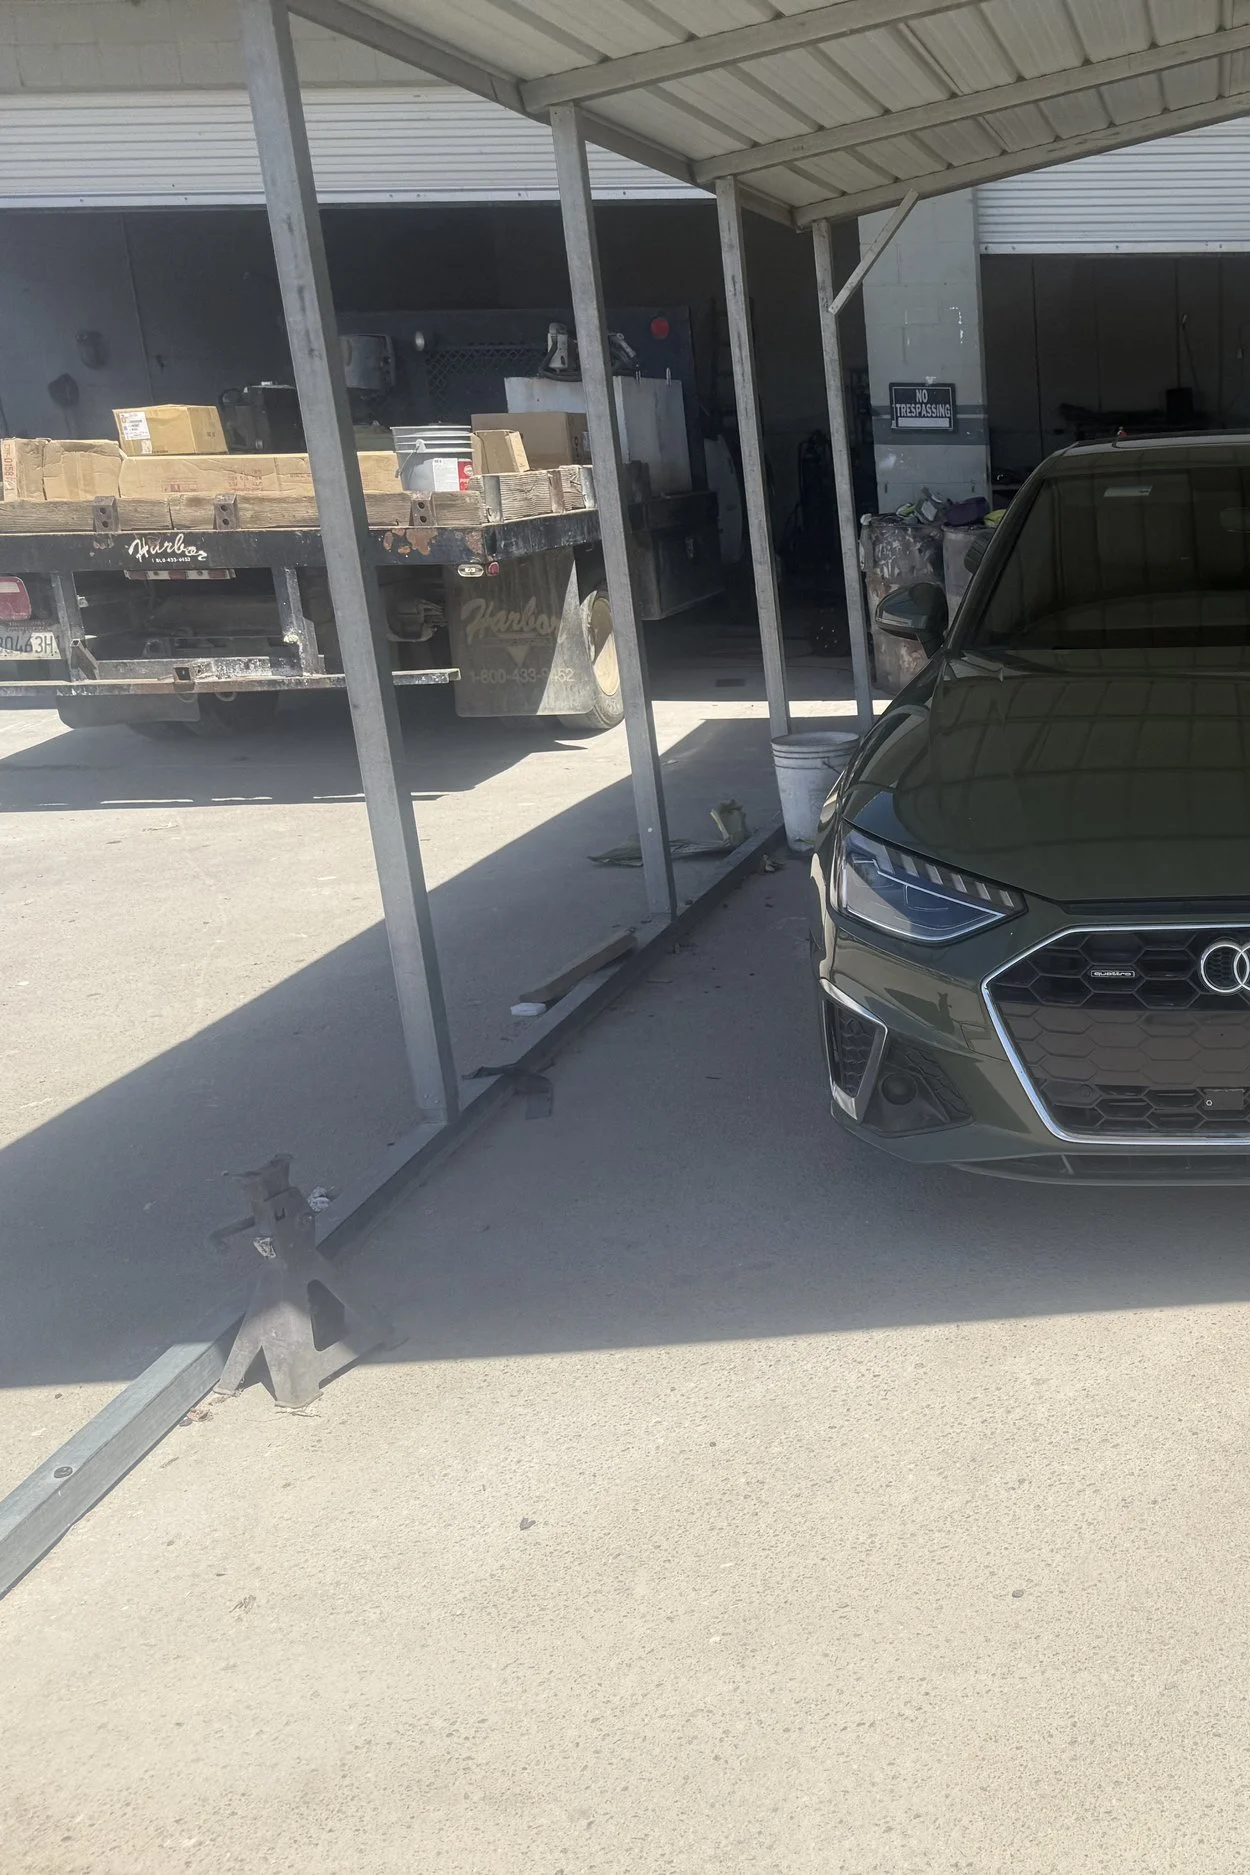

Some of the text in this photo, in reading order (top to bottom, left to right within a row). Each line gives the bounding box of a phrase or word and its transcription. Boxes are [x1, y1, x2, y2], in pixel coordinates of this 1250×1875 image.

[916, 389, 928, 402] NO
[895, 403, 951, 417] TRESPASSING
[460, 596, 568, 645] Harbor
